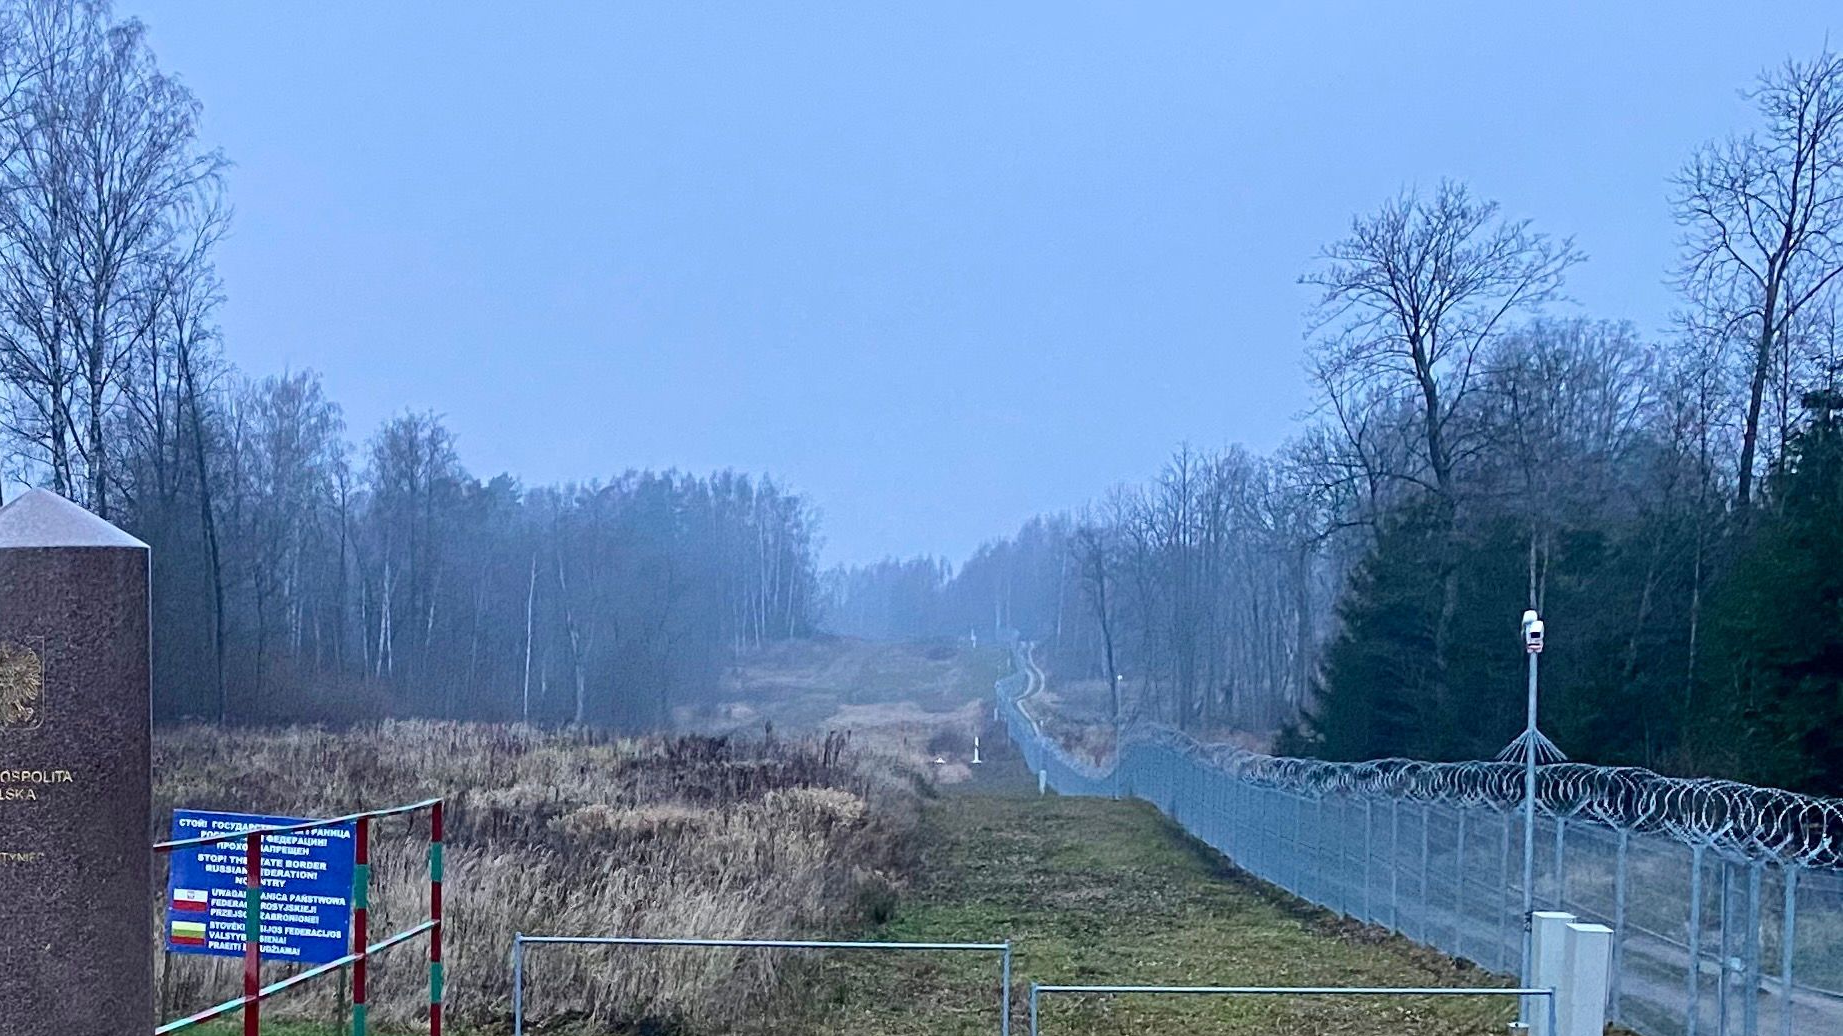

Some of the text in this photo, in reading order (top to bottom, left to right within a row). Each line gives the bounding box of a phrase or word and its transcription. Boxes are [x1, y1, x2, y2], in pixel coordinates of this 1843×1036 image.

[216, 841, 247, 851] ПРОХО
[285, 860, 326, 871] BORDER
[260, 892, 287, 902] ANICA
